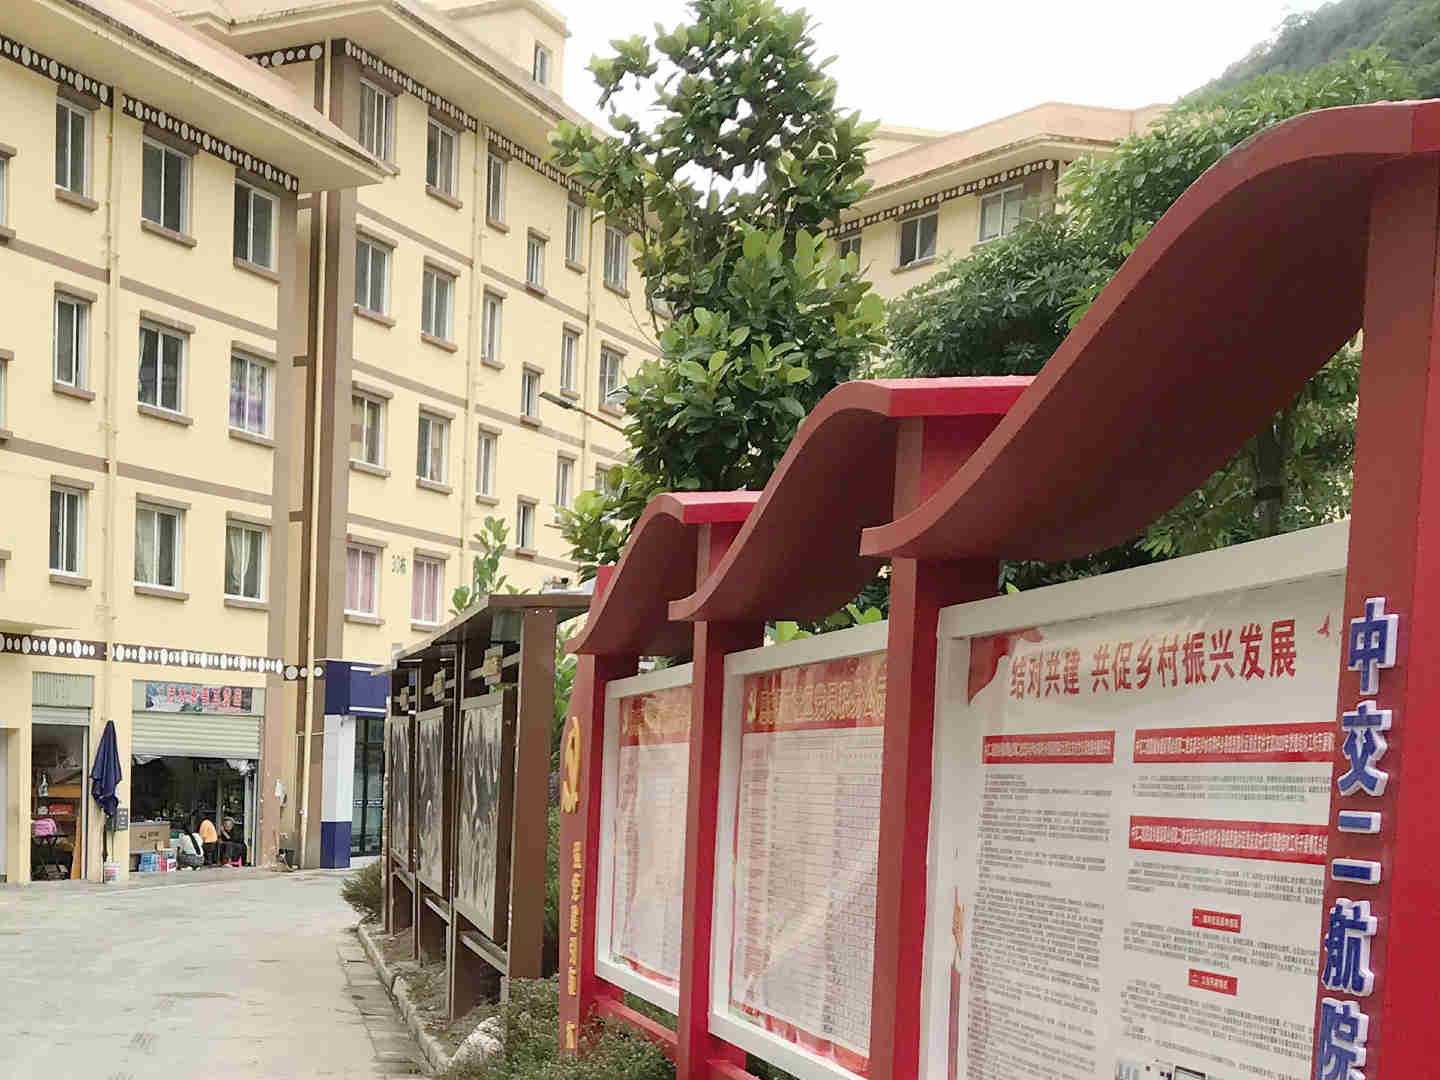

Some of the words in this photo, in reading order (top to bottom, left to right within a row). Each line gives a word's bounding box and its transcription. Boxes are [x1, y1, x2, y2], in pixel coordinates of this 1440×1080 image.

[1009, 648, 1081, 700] 结对共建
[1090, 619, 1297, 693] 共促乡村振兴发展
